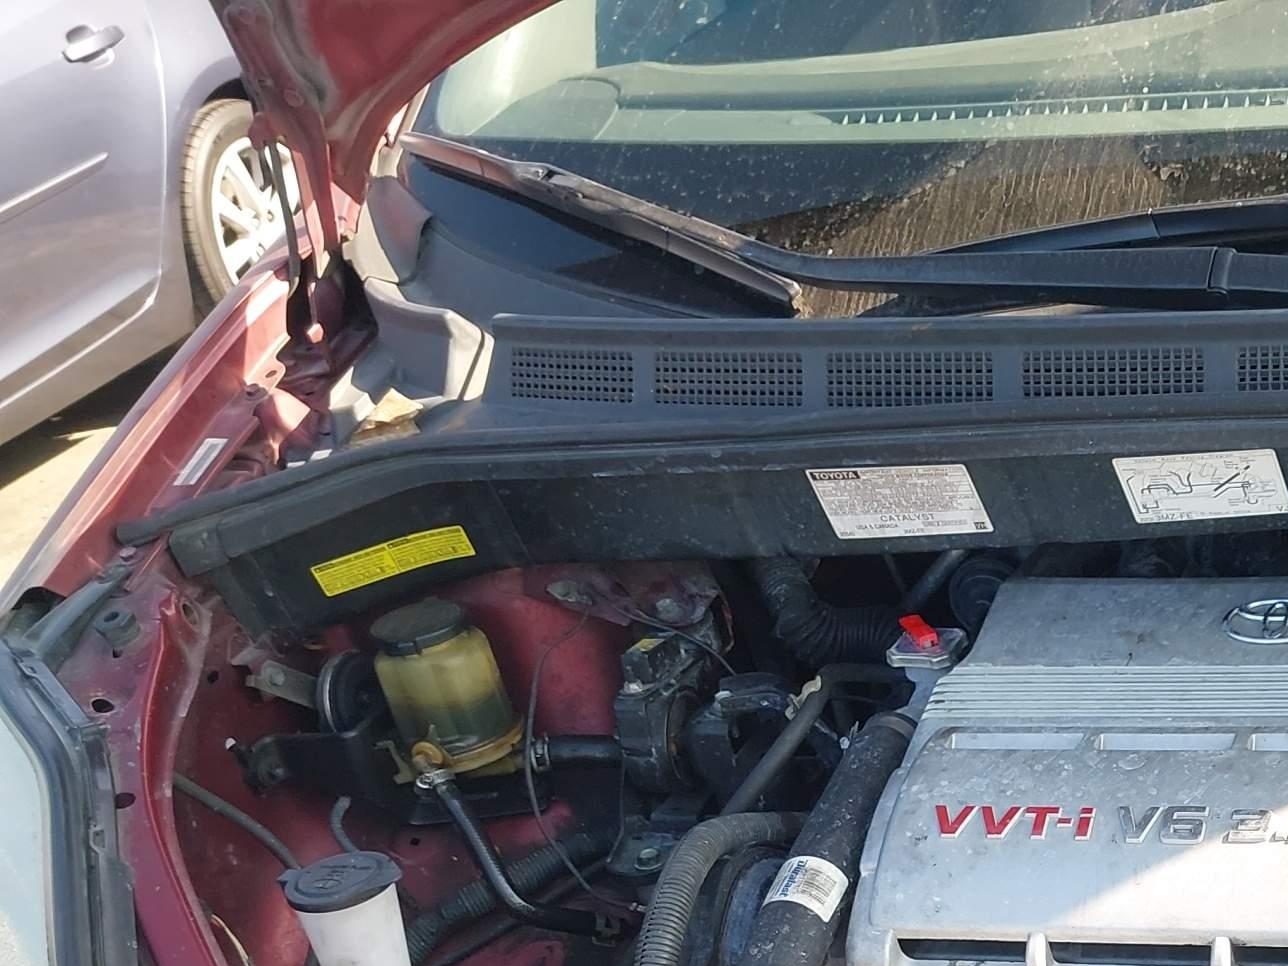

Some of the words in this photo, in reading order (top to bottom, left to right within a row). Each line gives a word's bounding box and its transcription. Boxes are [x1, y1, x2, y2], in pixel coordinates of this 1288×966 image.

[812, 471, 857, 481] TOYOTA
[880, 512, 936, 522] CATALYST
[934, 804, 1096, 842] VVT-i
[1115, 805, 1212, 844] V6
[778, 859, 808, 898] Duralast
